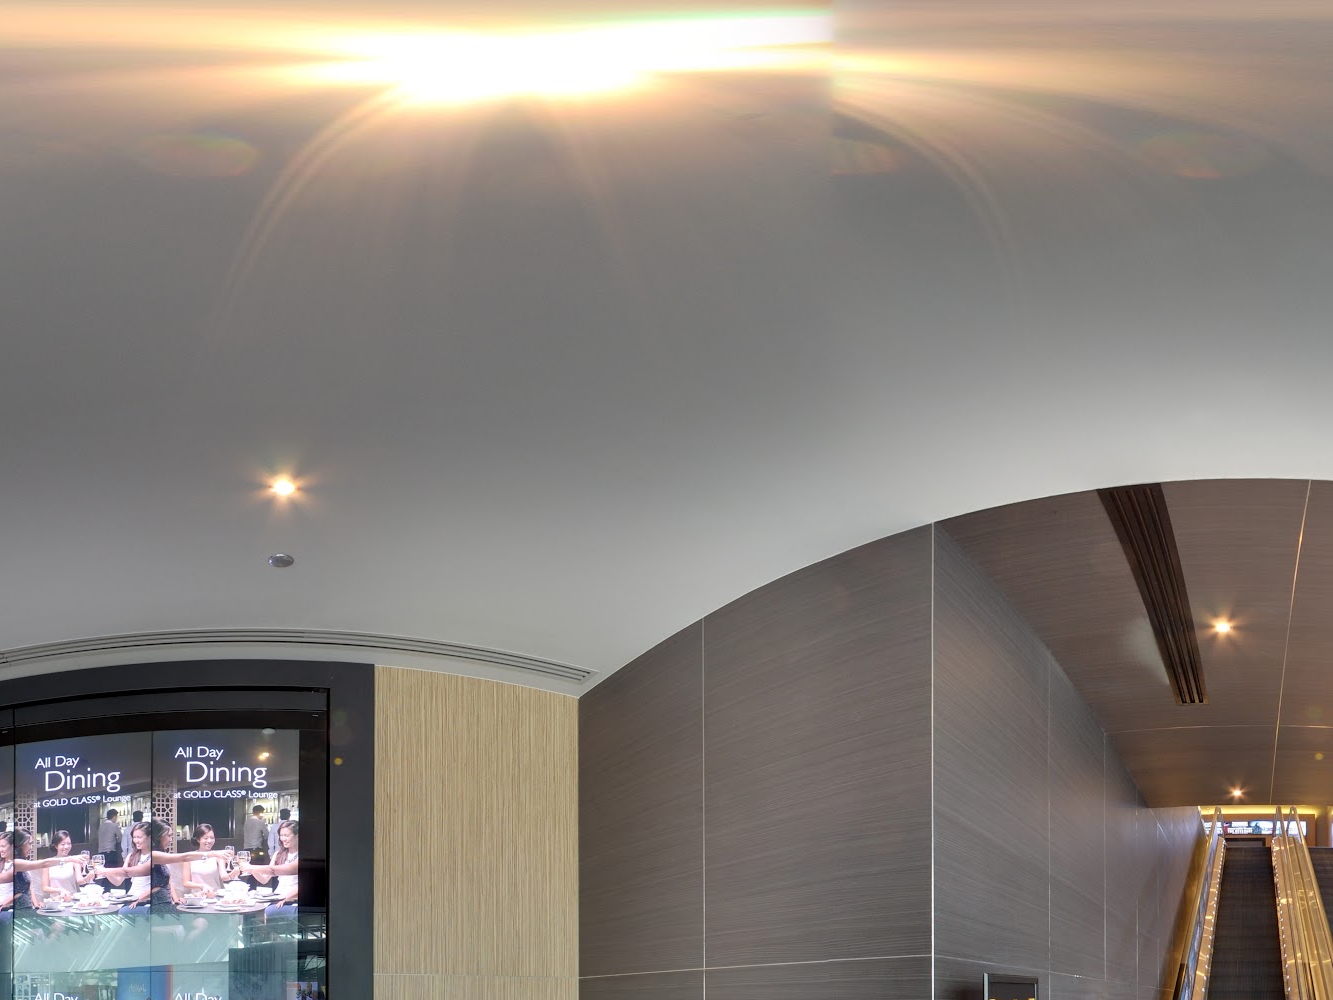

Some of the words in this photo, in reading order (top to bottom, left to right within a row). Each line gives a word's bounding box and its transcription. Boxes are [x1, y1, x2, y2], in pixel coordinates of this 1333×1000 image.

[174, 746, 192, 758] All
[197, 746, 224, 760] Day
[34, 757, 51, 769] All
[55, 756, 80, 768] Day
[45, 767, 121, 792] Dining
[186, 761, 267, 788] Dining
[42, 798, 68, 808] GOLD
[102, 794, 131, 803] Lounge
[183, 790, 211, 799] GOLD
[248, 790, 278, 800] Lounge
